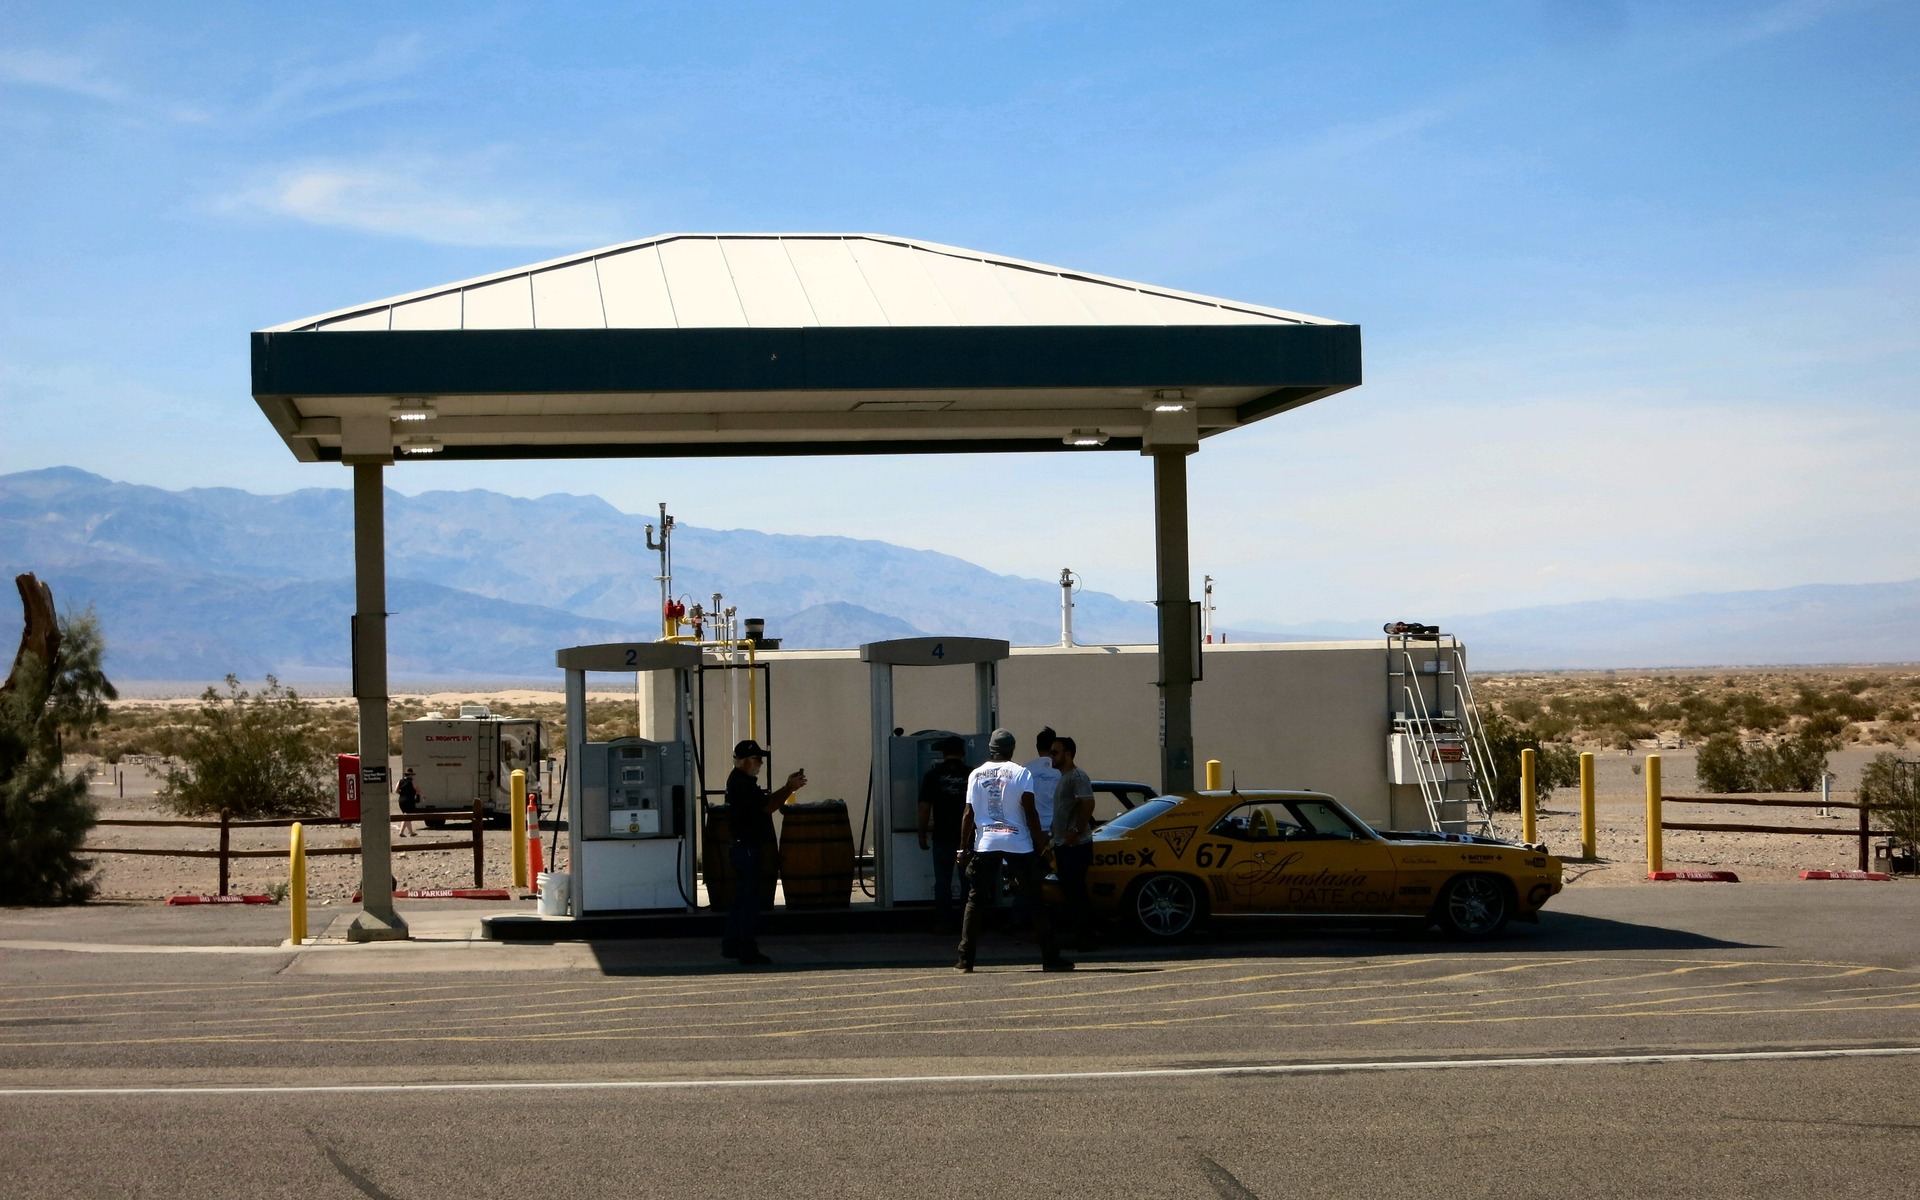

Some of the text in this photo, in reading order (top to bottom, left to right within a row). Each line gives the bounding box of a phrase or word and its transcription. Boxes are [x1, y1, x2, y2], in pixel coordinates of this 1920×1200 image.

[626, 649, 637, 665] 2
[932, 643, 944, 659] 4
[660, 745, 668, 755] 2
[968, 738, 976, 748] 4
[1159, 829, 1191, 838] GUESS
[1196, 843, 1233, 868] 67
[1226, 850, 1367, 897] Anastasia
